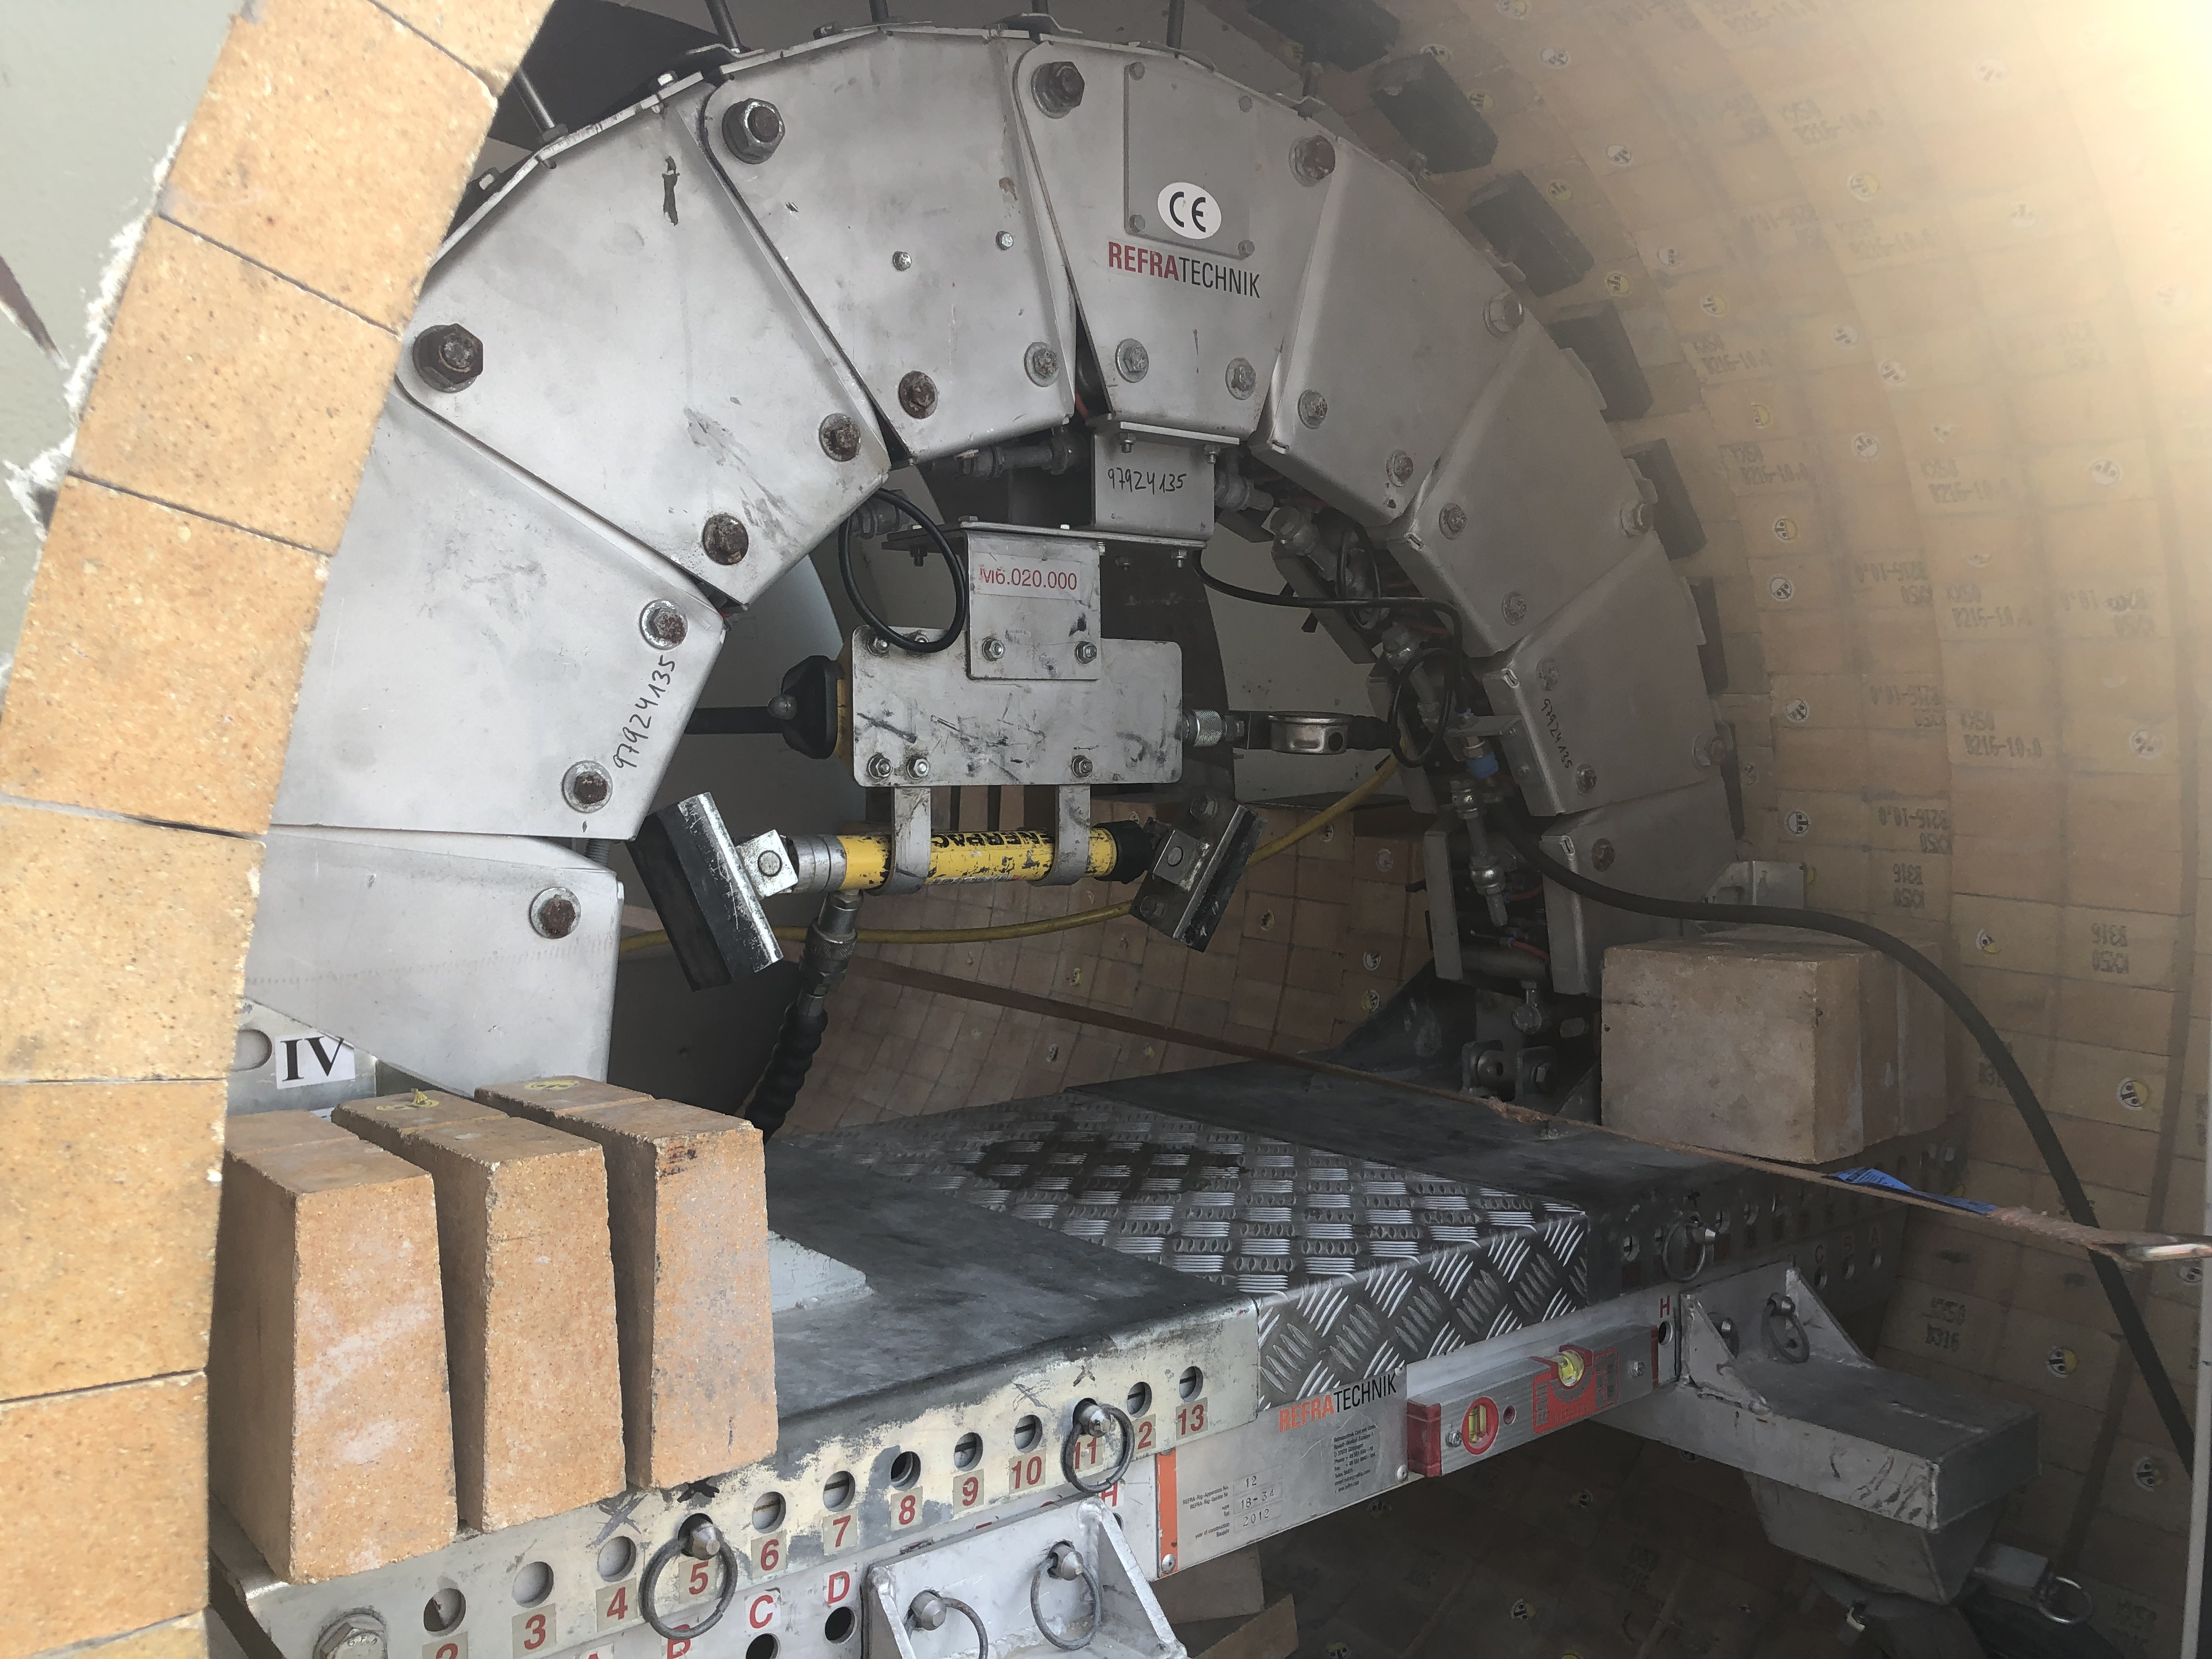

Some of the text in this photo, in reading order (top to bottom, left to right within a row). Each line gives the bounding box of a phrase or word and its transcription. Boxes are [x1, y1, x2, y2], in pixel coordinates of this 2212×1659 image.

[1169, 191, 1206, 233] CE
[1108, 241, 1260, 298] REFRATECHNIK
[1107, 467, 1188, 495] 97924135
[979, 567, 1077, 591] M6.020.000
[613, 654, 675, 769] 97924135
[280, 1036, 344, 1082] IV
[1660, 1295, 1670, 1318] H
[1278, 1373, 1397, 1432] REFRATECHNIK
[1137, 1421, 1152, 1449] 2
[1178, 1404, 1204, 1435] 13
[1074, 1437, 1096, 1470] 11
[1015, 1457, 1042, 1489] 10
[1246, 1475, 1257, 1488] 12
[964, 1477, 977, 1505] 9
[899, 1496, 915, 1525] 8
[1243, 1508, 1269, 1527] 2012
[833, 1515, 851, 1548] 7
[760, 1539, 779, 1571] 6
[689, 1561, 709, 1595] 5
[827, 1571, 850, 1604] D
[607, 1587, 628, 1620] 4
[749, 1594, 775, 1629] C
[524, 1614, 546, 1650] 3
